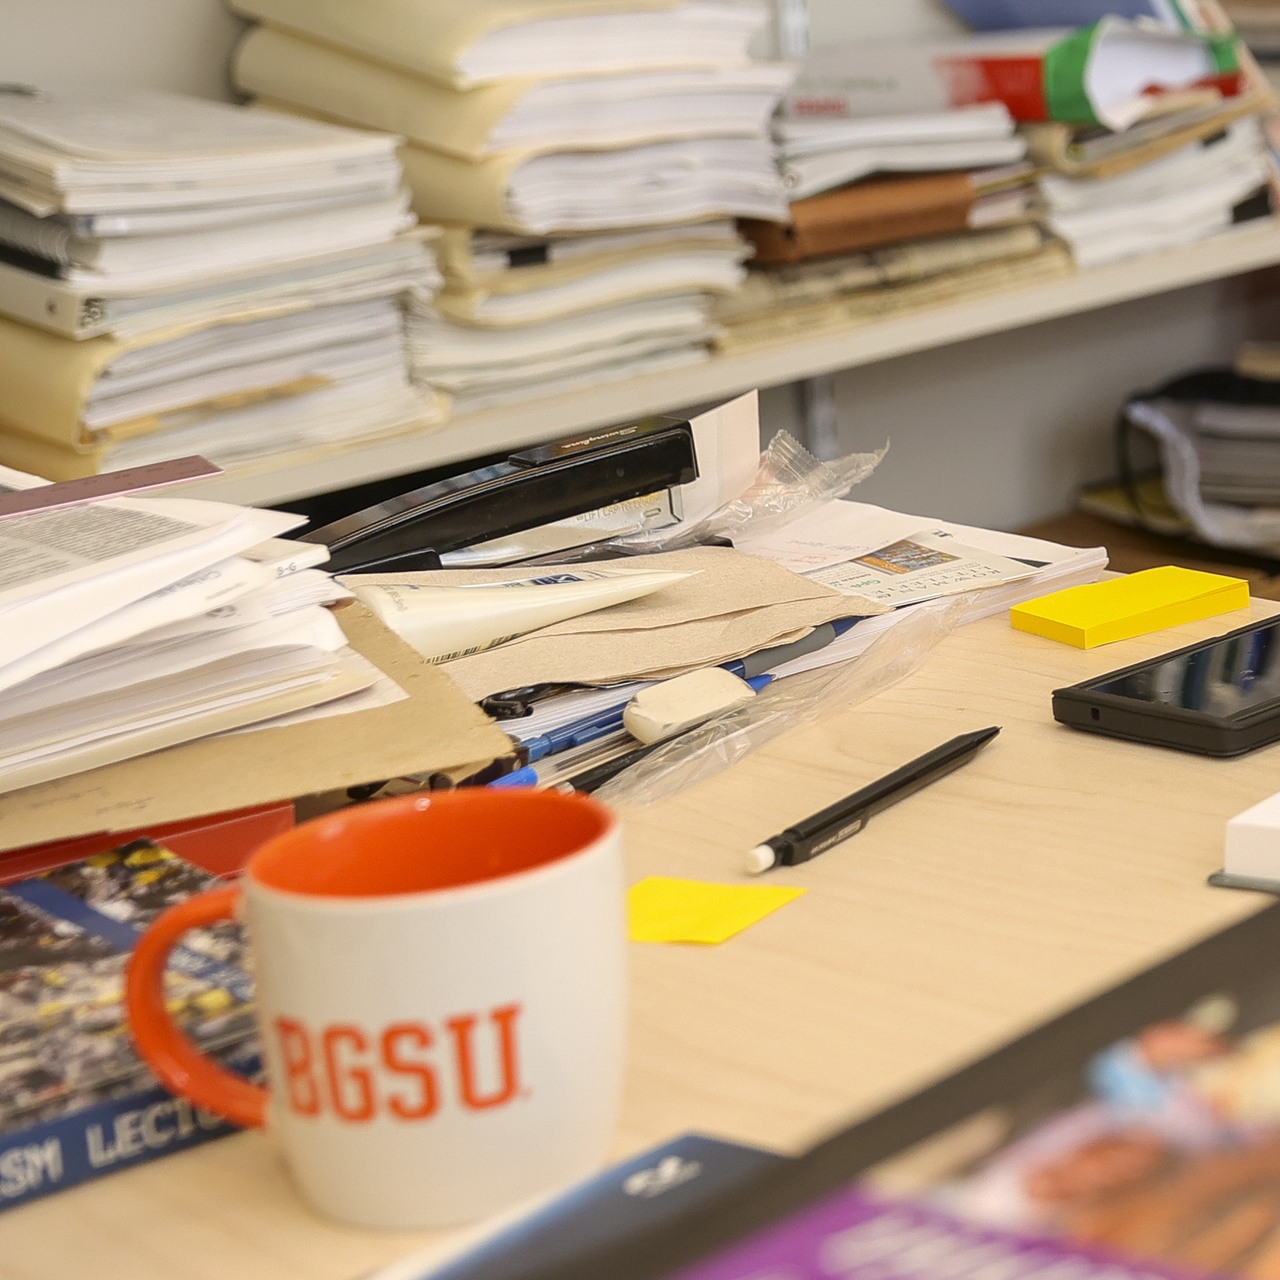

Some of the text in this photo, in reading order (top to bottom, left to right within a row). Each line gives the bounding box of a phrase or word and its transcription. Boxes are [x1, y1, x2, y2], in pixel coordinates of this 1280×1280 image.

[562, 425, 638, 449] Swingline
[900, 568, 1002, 595] ROWMAN
[274, 1002, 521, 1122] BGSU
